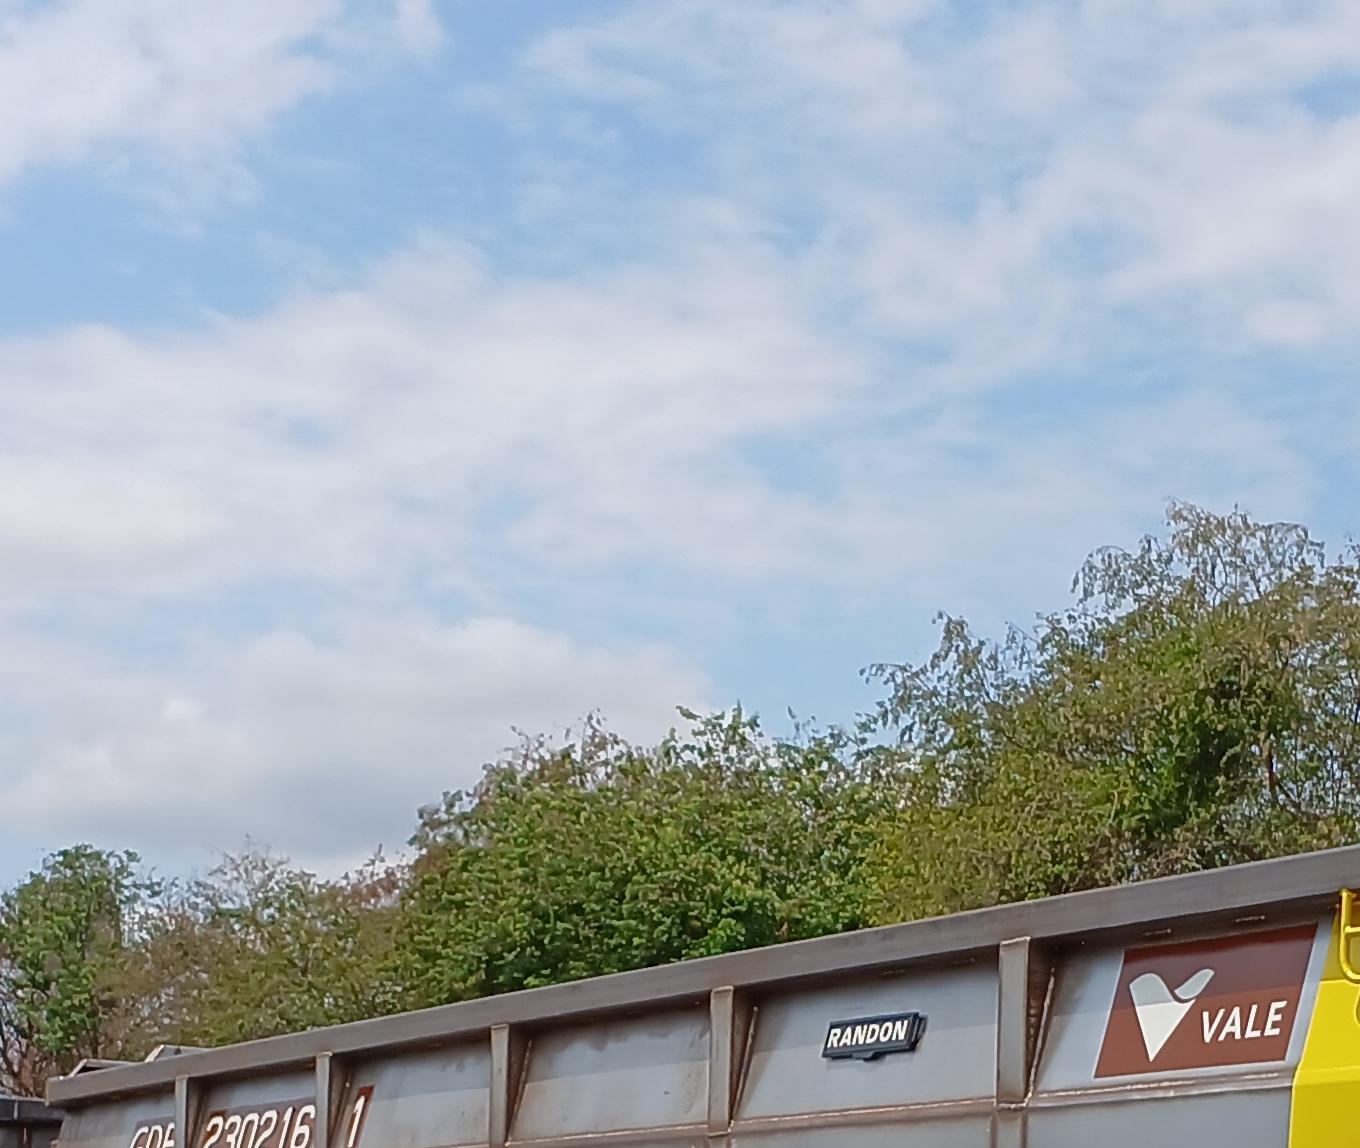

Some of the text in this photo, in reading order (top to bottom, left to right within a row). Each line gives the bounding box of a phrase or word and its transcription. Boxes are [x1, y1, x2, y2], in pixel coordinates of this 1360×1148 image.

[827, 1020, 908, 1048] RANDON
[1202, 1000, 1288, 1043] VALE
[348, 1095, 365, 1148] 1
